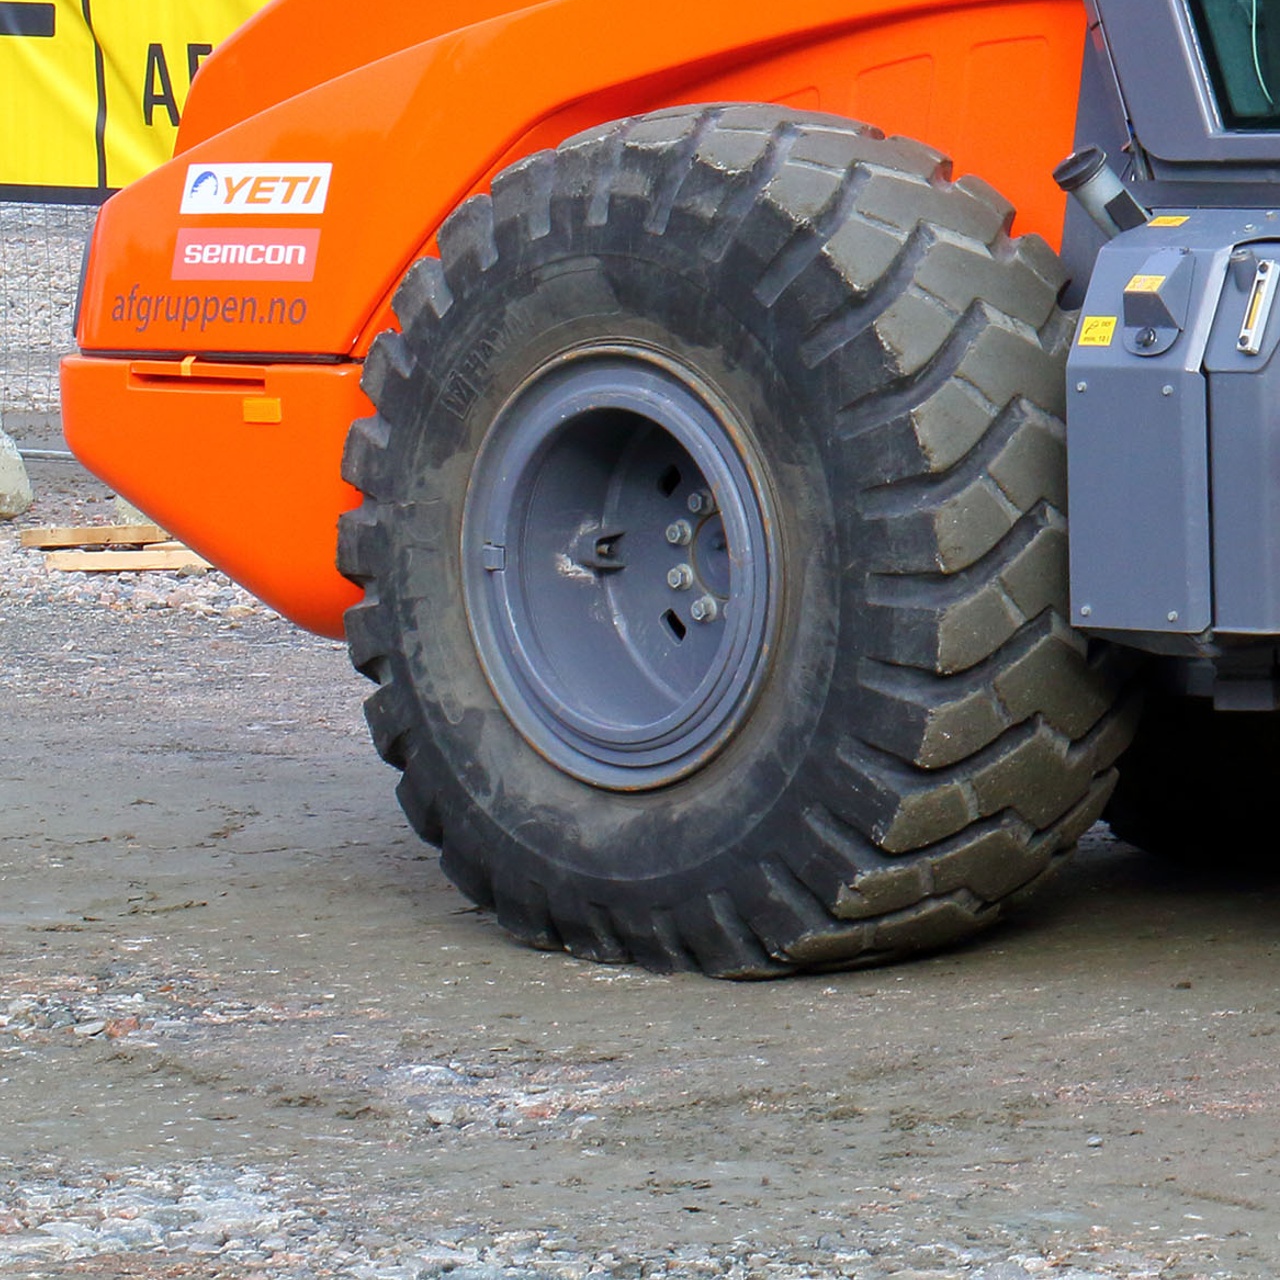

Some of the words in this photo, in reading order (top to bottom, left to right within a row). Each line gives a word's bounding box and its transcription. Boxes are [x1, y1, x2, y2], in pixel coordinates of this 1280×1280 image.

[223, 176, 322, 205] YETI
[183, 244, 307, 265] semcon
[111, 282, 308, 333] afgruppen.no
